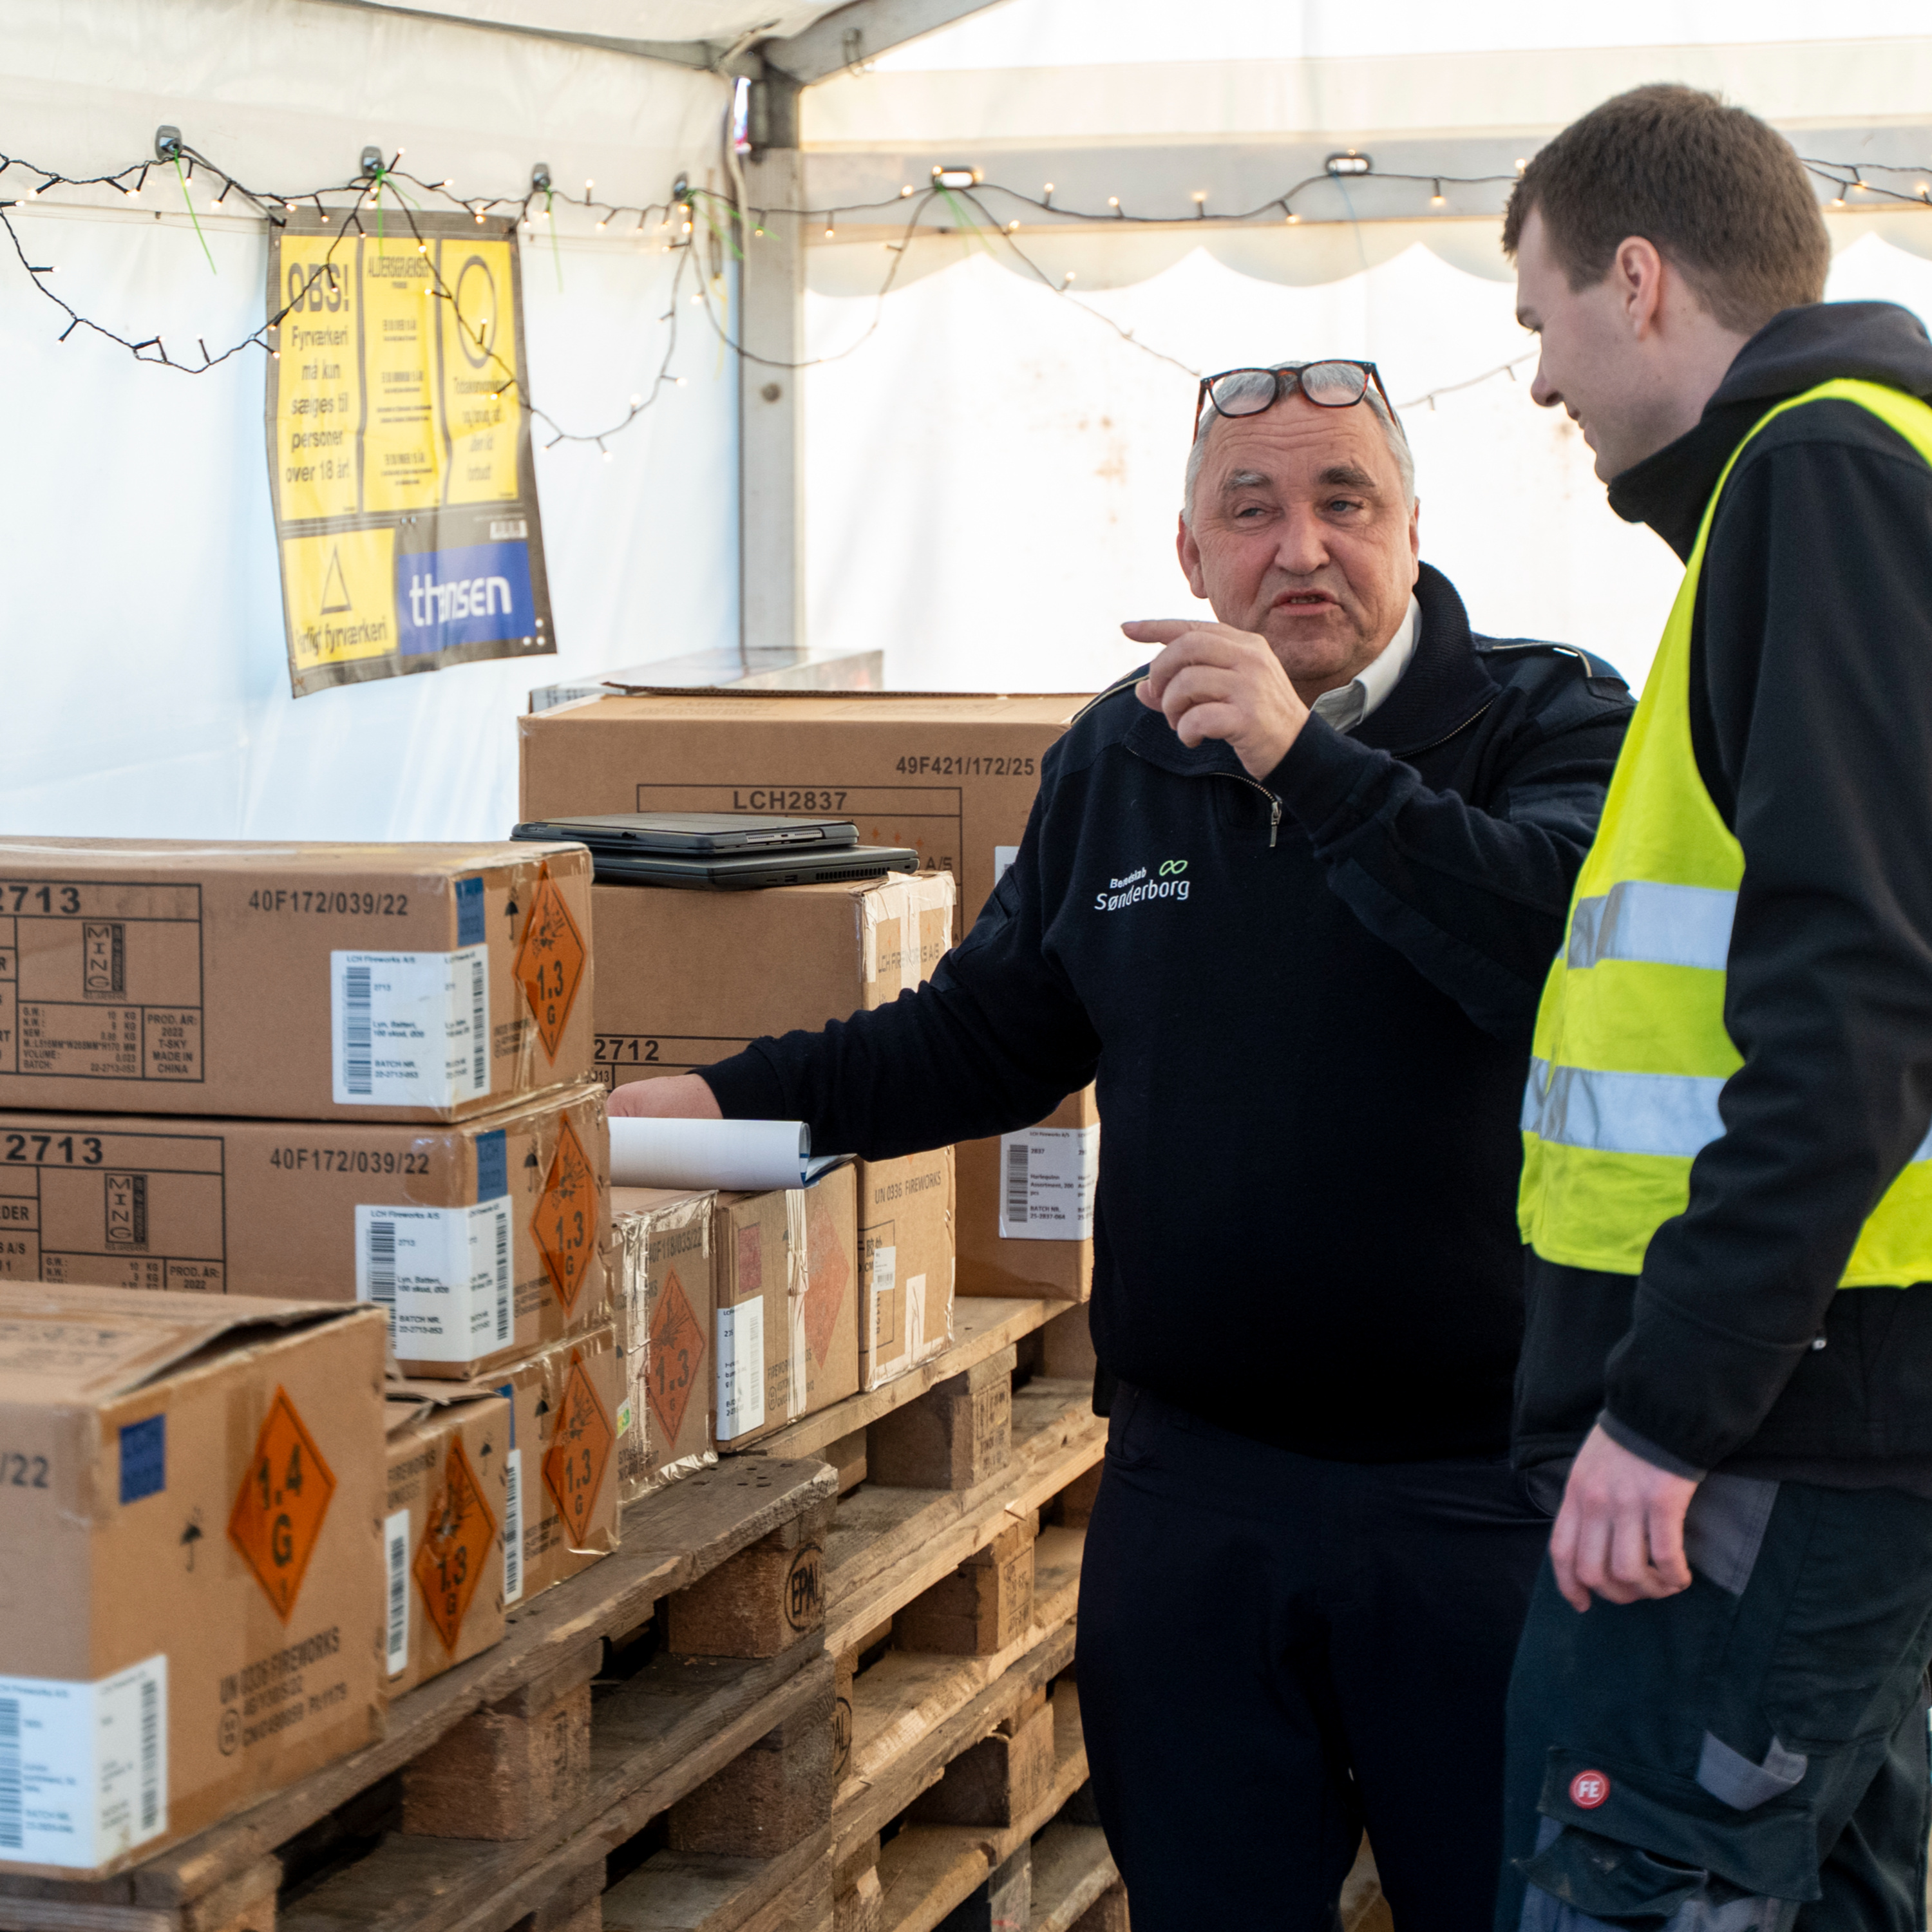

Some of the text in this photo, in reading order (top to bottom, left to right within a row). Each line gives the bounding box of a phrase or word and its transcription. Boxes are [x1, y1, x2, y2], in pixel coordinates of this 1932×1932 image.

[288, 262, 350, 313] OBS!
[291, 326, 349, 352] Fyrværkeri
[301, 358, 341, 380] må kun
[291, 397, 335, 418] sælges
[291, 430, 344, 453] personer
[285, 465, 316, 484] over
[319, 460, 334, 480] 18
[409, 573, 513, 628] thnsen
[324, 615, 387, 654] fyrværkeri
[896, 755, 1036, 776] 49F421/172/25
[733, 790, 848, 811] LCH2837
[925, 856, 953, 871] A/S
[0, 886, 81, 914] 713
[249, 889, 409, 916] 40F172/039/22
[1094, 880, 1191, 911] Sønderborg
[364, 955, 401, 964] Fireworks
[537, 960, 564, 1001] 1.3
[124, 1012, 137, 1021] KG
[147, 1014, 177, 1025] PROD.
[546, 1004, 556, 1025] G
[124, 1022, 137, 1031] KG
[152, 1050, 181, 1061] MADE
[594, 1038, 659, 1062] 2712
[156, 1063, 189, 1074] CHINA
[374, 1060, 401, 1068] BATCH
[5, 1133, 104, 1165] 2713
[269, 1148, 430, 1175] 40F172/039/22
[874, 1170, 942, 1205] UN 0336 FIREWORKS
[388, 1210, 424, 1219] Fireworks
[555, 1210, 584, 1253] 1.3
[147, 1262, 159, 1272] KG
[169, 1265, 198, 1277] PROD.
[565, 1255, 574, 1276] G
[147, 1273, 159, 1283] KG
[399, 1315, 426, 1324] BATCH
[655, 1348, 690, 1396] 1.3
[258, 1444, 304, 1511] 1.4
[565, 1448, 592, 1494] 1.3
[574, 1493, 583, 1516] G
[271, 1513, 293, 1569] G
[1578, 1781, 1600, 1798] FE
